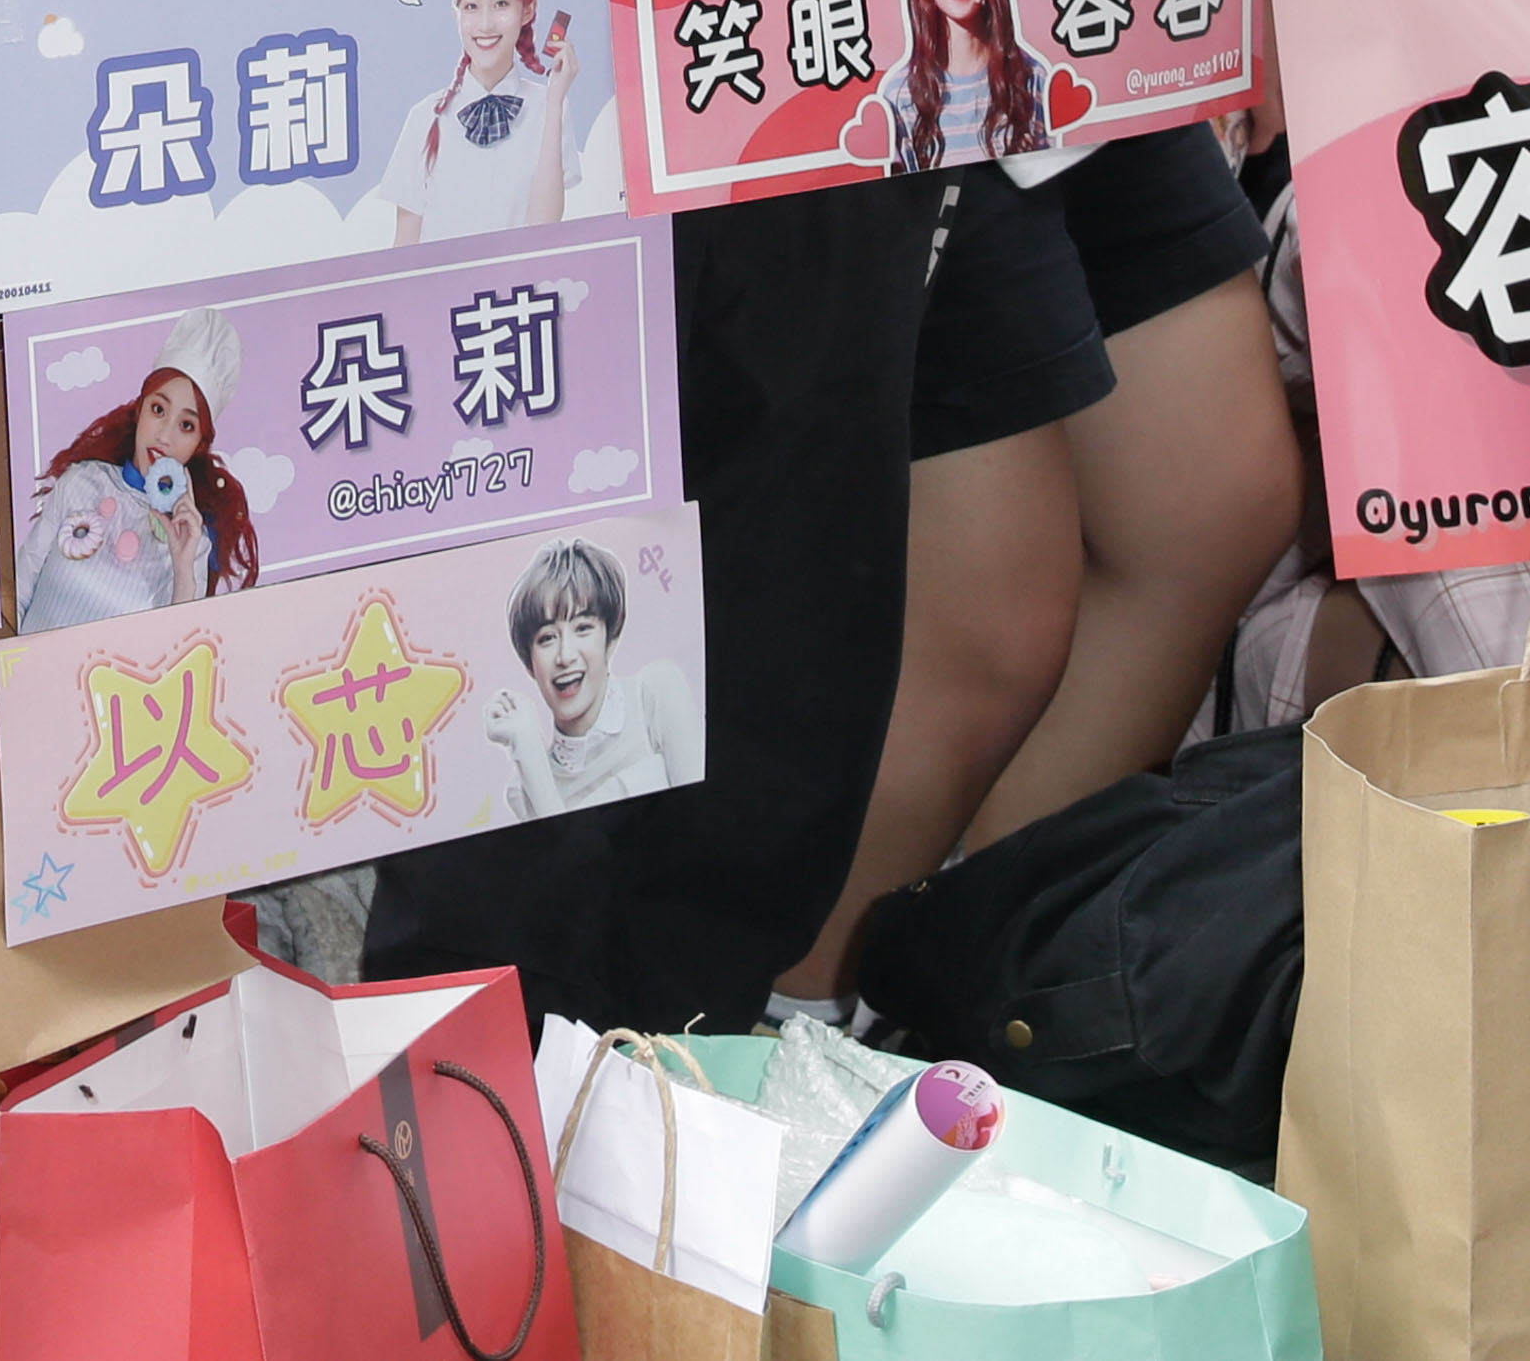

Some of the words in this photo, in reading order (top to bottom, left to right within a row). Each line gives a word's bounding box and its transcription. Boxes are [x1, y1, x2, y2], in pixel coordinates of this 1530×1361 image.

[100, 41, 350, 192] 朵莉
[304, 289, 560, 445] 朵莉
[327, 449, 534, 523] @chiayi727
